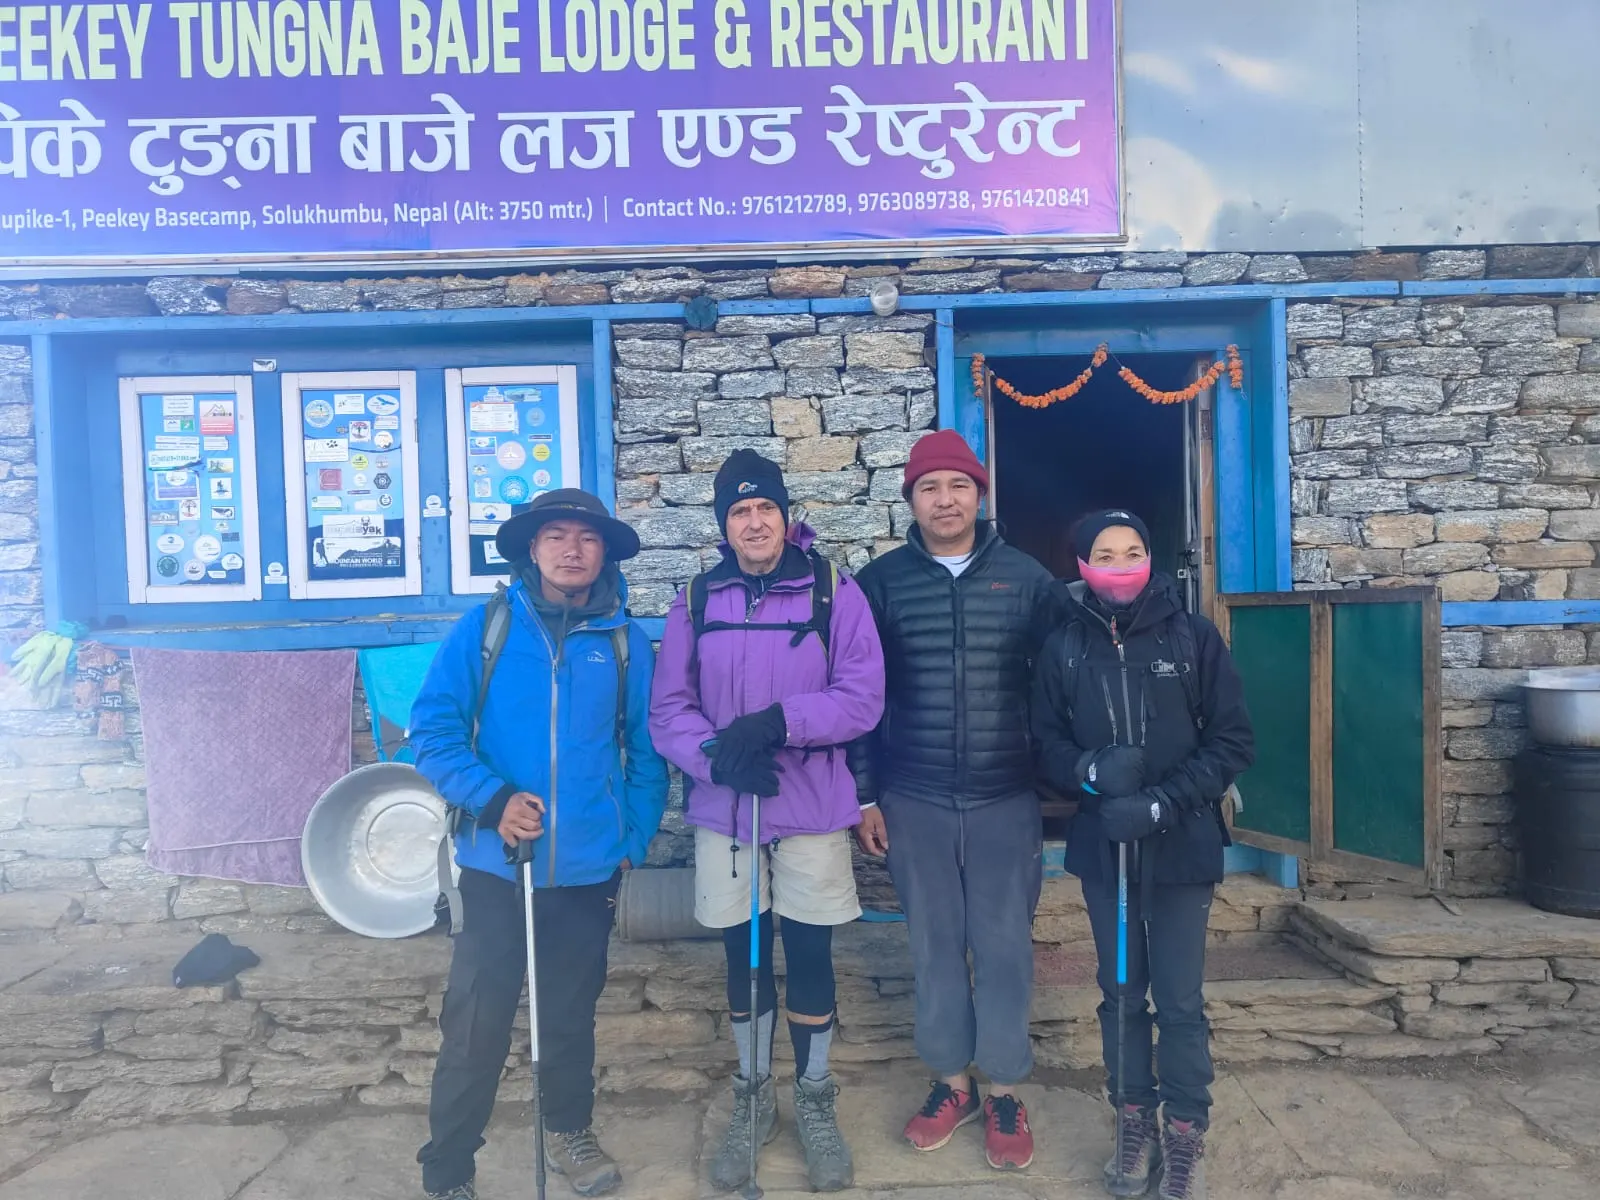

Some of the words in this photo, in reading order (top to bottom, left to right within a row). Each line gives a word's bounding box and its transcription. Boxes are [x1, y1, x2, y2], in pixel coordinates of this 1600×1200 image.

[169, 0, 384, 78] TUNGNA
[400, 0, 521, 74] BAJE
[538, 0, 695, 73] LODGE
[714, 0, 752, 68] &
[128, 116, 316, 196] टुङ्ना
[339, 93, 475, 172] बाजे
[498, 110, 635, 174] लज
[657, 106, 802, 169] एण्ड
[825, 81, 1085, 179] रेष्टुरेन्ट
[1, 208, 76, 234] upike-1,
[82, 207, 150, 232] Peekey
[155, 207, 257, 230] Basecamp,
[262, 203, 388, 226] Solukhumbu,
[394, 201, 448, 227] Nepal
[454, 200, 494, 224] (Alt:
[499, 201, 543, 221] 3750
[549, 197, 593, 222] mtr.)
[623, 198, 694, 217] Contact
[698, 196, 737, 216] No.:
[742, 193, 852, 216] 9761212789,
[858, 190, 976, 212] 9763089738,
[981, 187, 1089, 208] 9761420841
